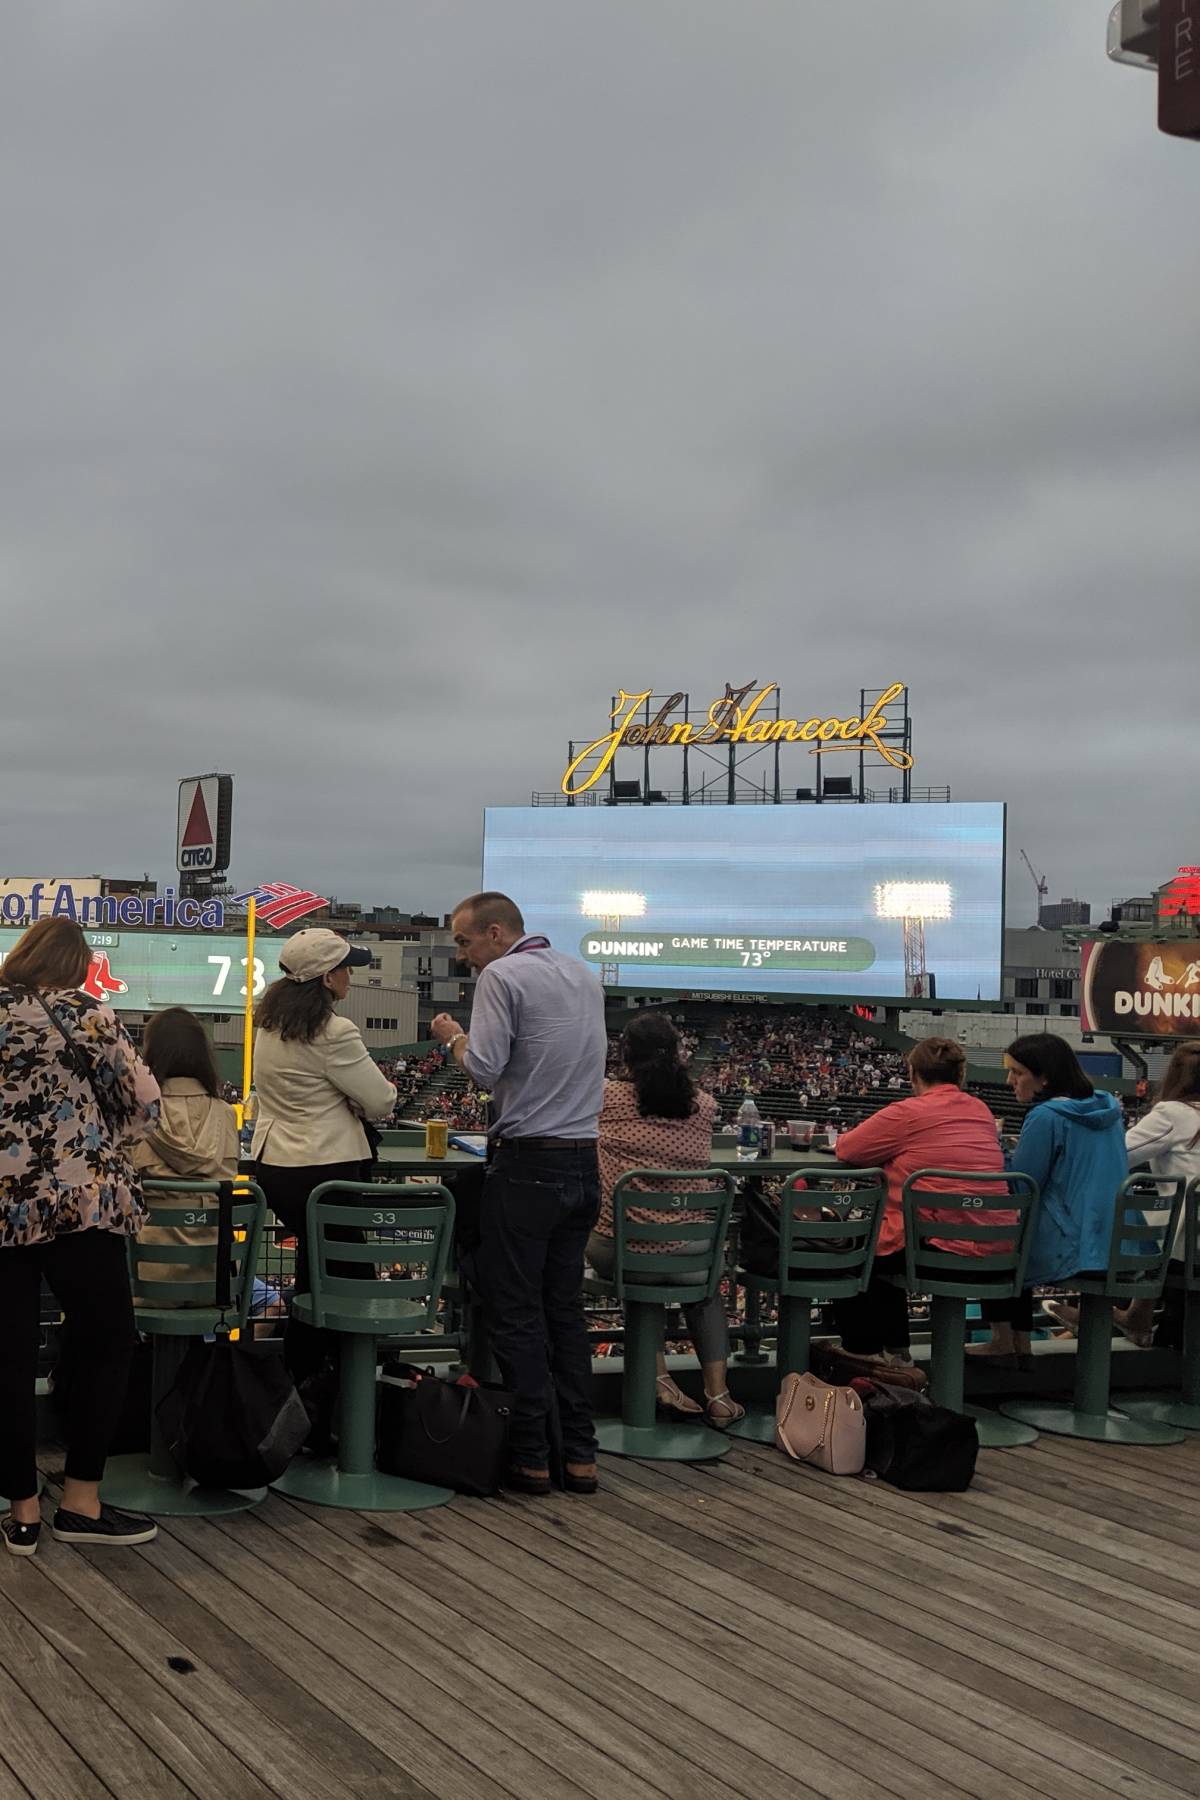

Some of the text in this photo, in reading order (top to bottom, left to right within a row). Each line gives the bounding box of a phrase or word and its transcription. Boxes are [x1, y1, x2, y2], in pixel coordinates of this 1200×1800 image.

[1176, 0, 1193, 80] RE
[562, 679, 914, 795] John Hancock
[181, 847, 212, 867] CITGO
[1, 883, 45, 921] of
[50, 884, 225, 928] America
[91, 935, 113, 945] 7:19
[672, 937, 847, 952] GAME TIME TEMPERATURE
[588, 940, 664, 957] DUNKIN'
[207, 955, 266, 996] 73
[1036, 968, 1064, 978] Hotel
[691, 992, 768, 1001] MITSUBISHI ELECTRIC
[671, 1197, 688, 1207] 31
[833, 1195, 852, 1205] 30
[962, 1198, 984, 1208] 29
[183, 1212, 207, 1225] 34
[372, 1212, 396, 1225] 33
